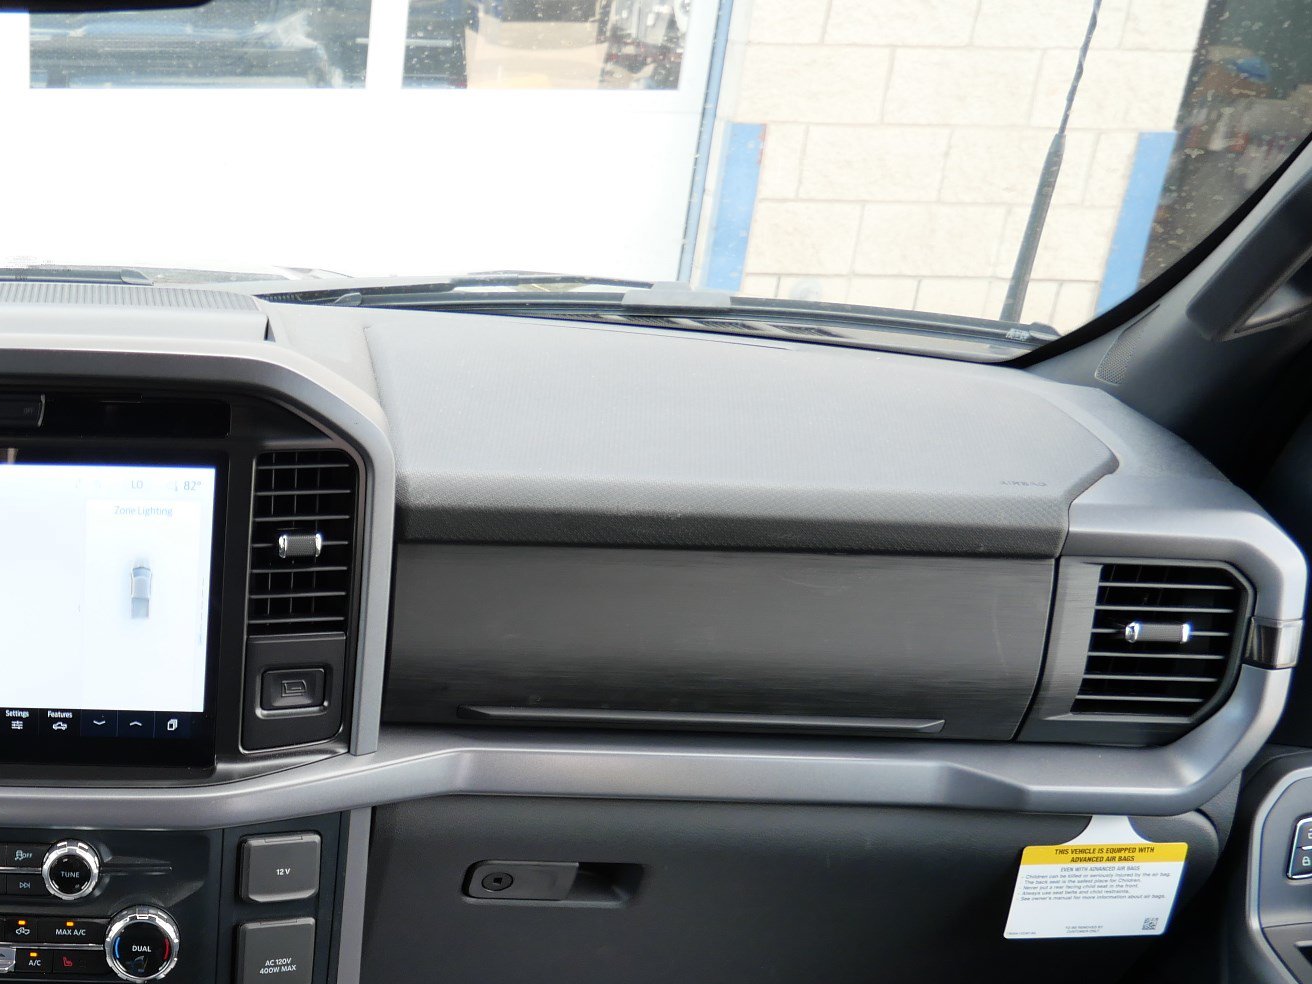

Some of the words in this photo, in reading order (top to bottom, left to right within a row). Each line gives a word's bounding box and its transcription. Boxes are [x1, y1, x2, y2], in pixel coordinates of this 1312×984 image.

[114, 505, 136, 515] Zone
[137, 506, 173, 517] Lighting
[5, 709, 30, 718] Settings
[47, 710, 73, 718] Features
[60, 870, 80, 878] TUNE
[275, 868, 284, 876] 12
[55, 928, 72, 936] MAX
[73, 928, 86, 936] A/C
[131, 945, 152, 953] DUAL
[28, 959, 42, 967] A/C
[265, 959, 275, 967] AC
[275, 958, 292, 966] 120V
[259, 966, 280, 975] 400W
[280, 965, 297, 973] MAX
